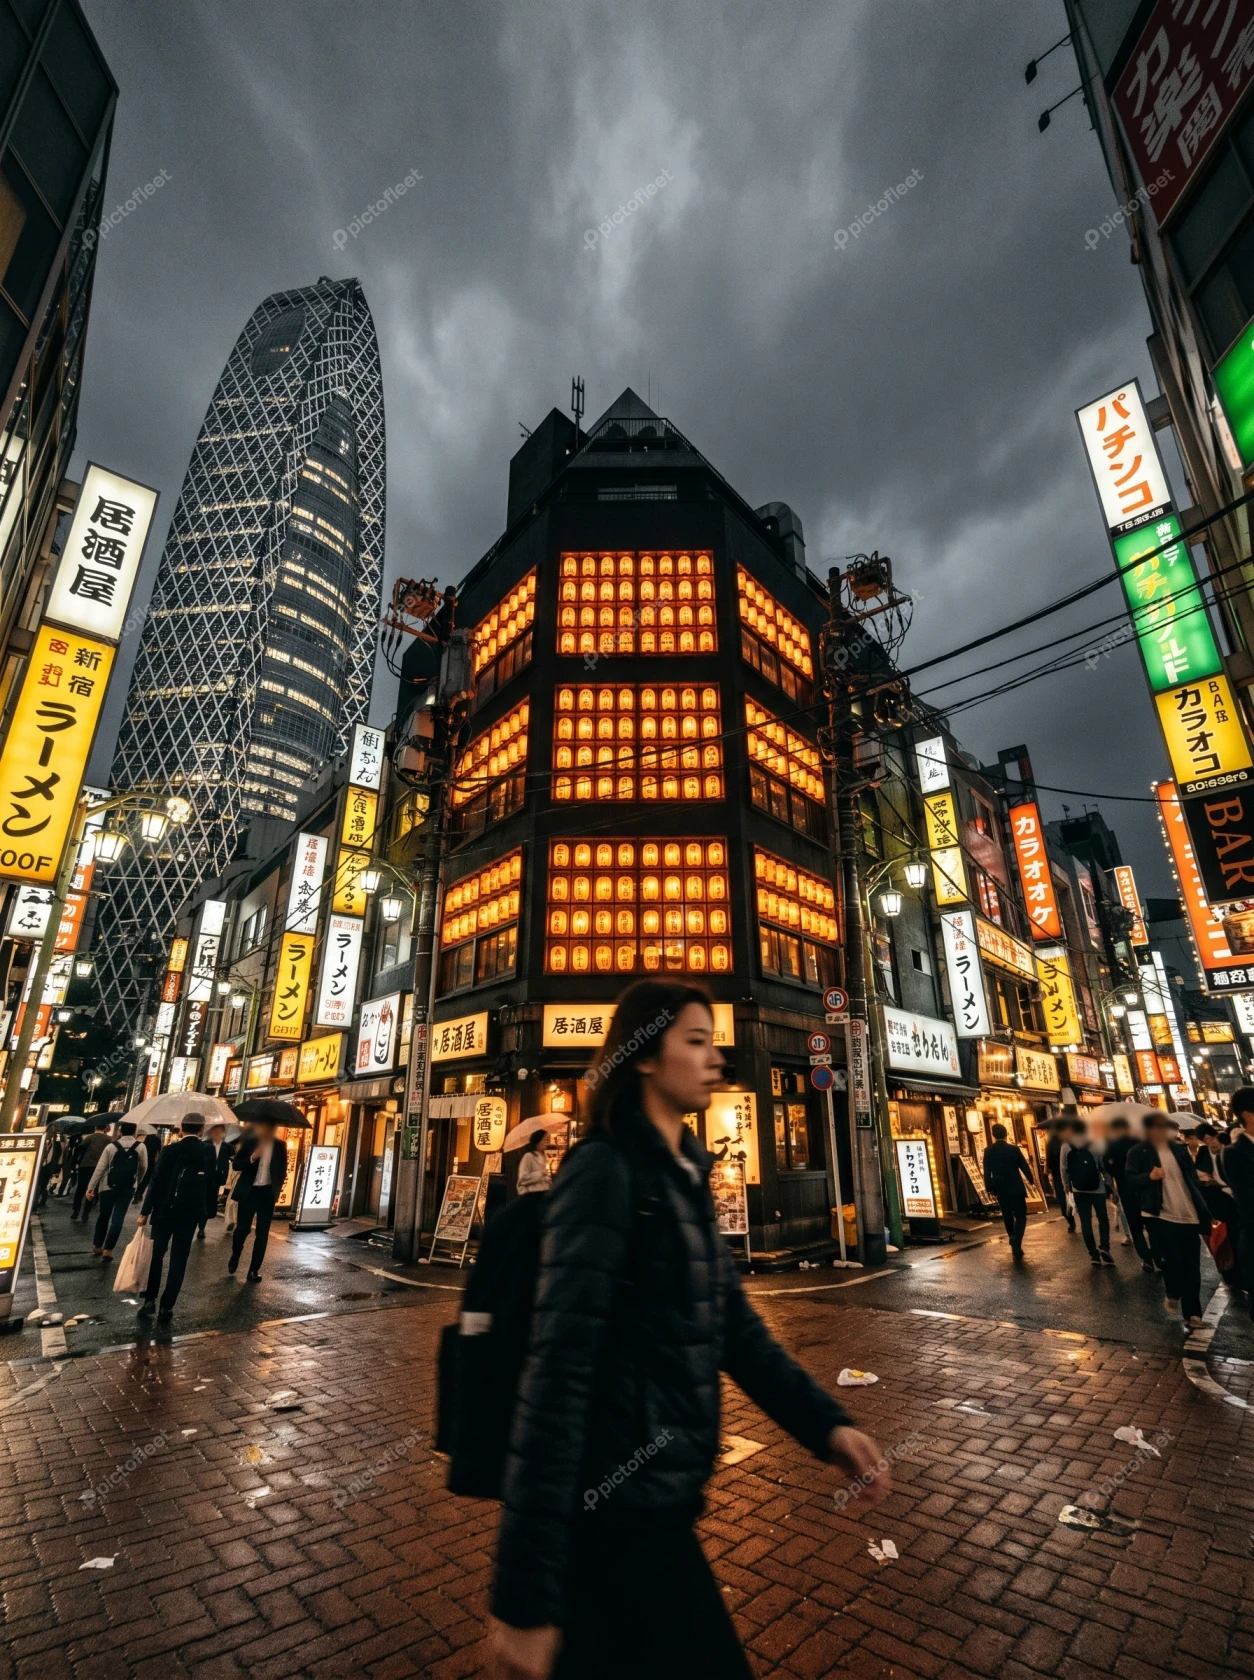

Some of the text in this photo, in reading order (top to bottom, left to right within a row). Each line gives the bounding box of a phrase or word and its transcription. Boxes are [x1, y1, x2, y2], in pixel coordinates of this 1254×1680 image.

[1097, 393, 1154, 515] パチンコ
[69, 495, 137, 608] 居酒屋
[68, 648, 102, 697] 新宿
[2, 701, 77, 837] ラーメン
[1174, 688, 1221, 775] カラオコ
[0, 849, 53, 872] OOF
[1016, 816, 1053, 926] カラオオケ
[1204, 796, 1254, 891] BAR
[277, 944, 307, 1021] ラーメン
[330, 934, 352, 996] ラーメン
[956, 955, 980, 1030] ラーメン
[440, 1020, 476, 1054] 居酒屋
[552, 1016, 613, 1035] 居酒屋
